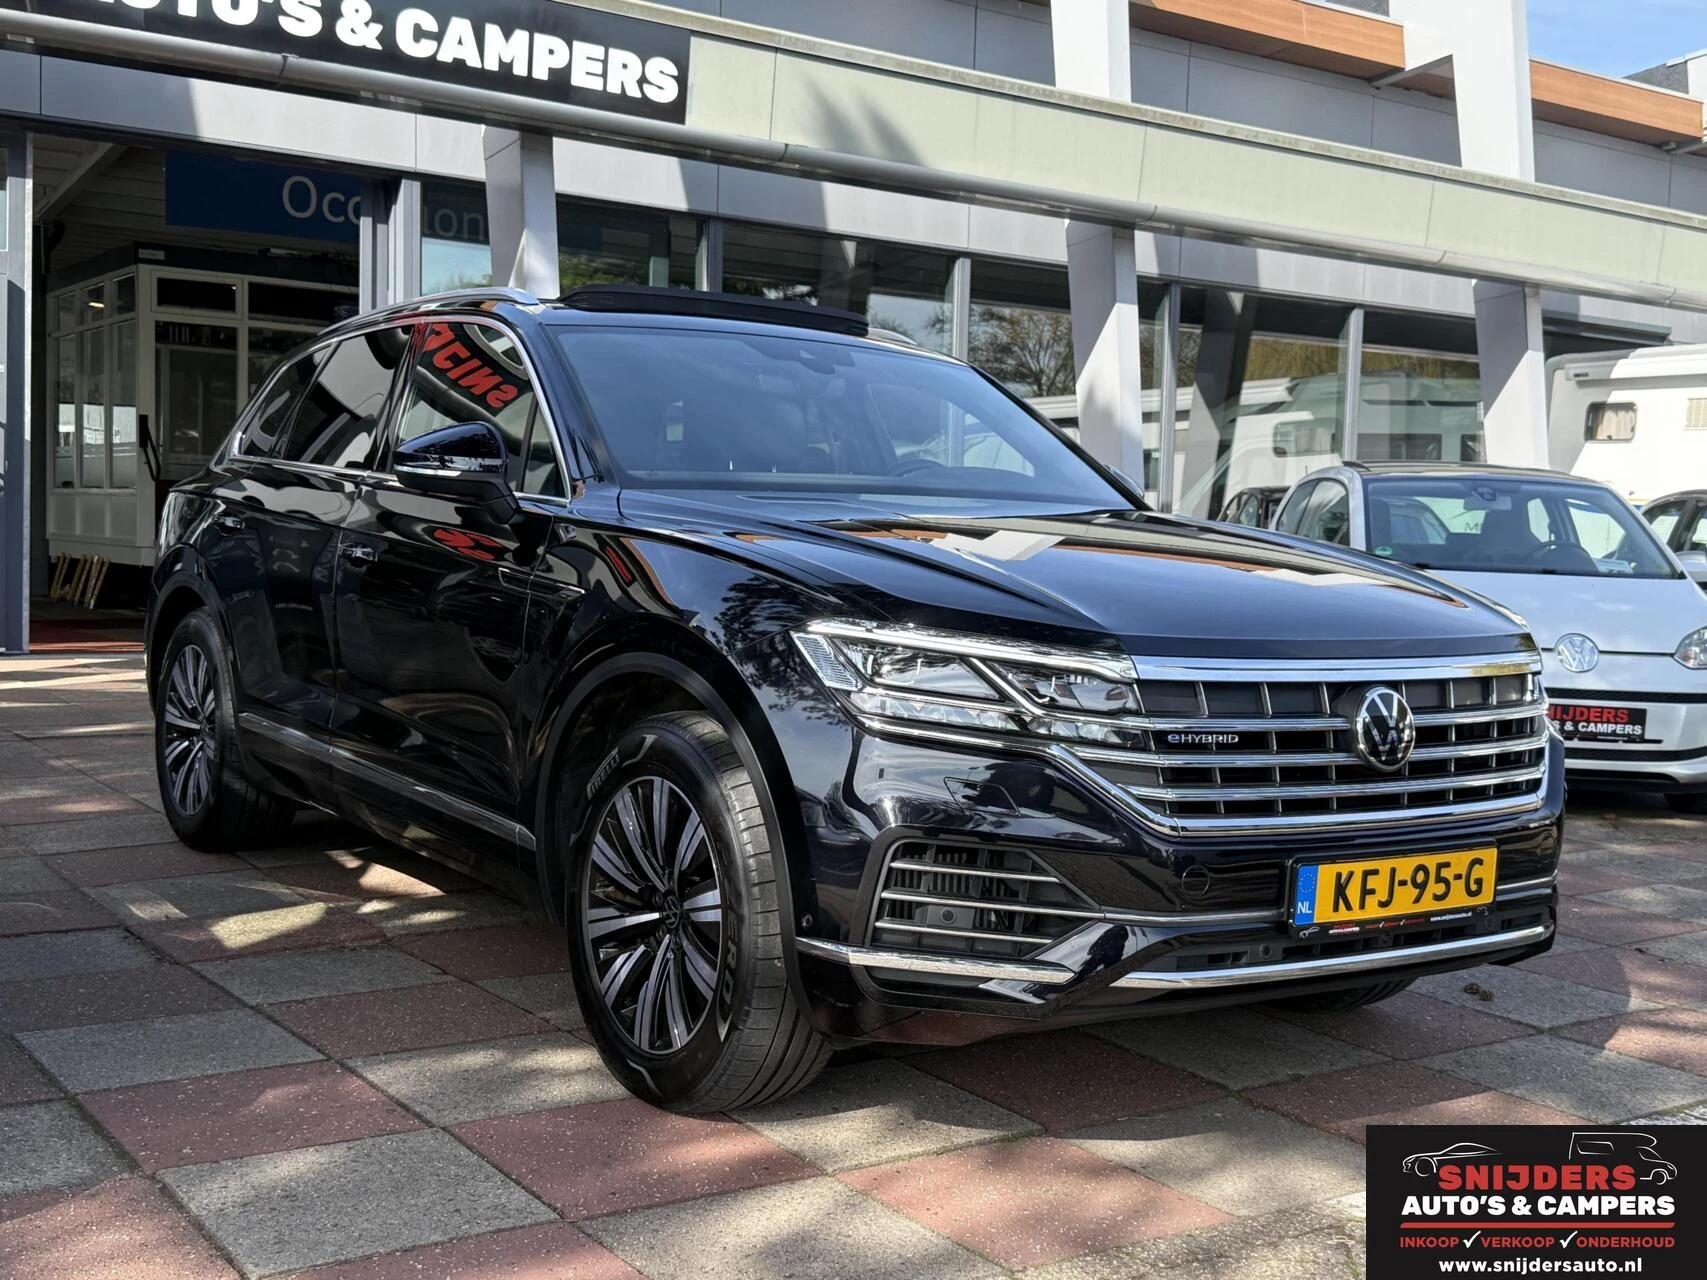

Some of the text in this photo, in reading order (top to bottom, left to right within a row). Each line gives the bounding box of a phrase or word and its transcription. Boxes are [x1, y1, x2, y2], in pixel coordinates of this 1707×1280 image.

[336, 0, 384, 50] &
[396, 9, 680, 104] CAMPERS
[1548, 704, 1629, 724] NIJDERS
[1564, 721, 1574, 731] &
[1578, 722, 1642, 735] CAMPERS
[587, 746, 620, 800] PIRELLI
[1332, 857, 1484, 913] KFJ-95-G
[1297, 901, 1312, 914] NL
